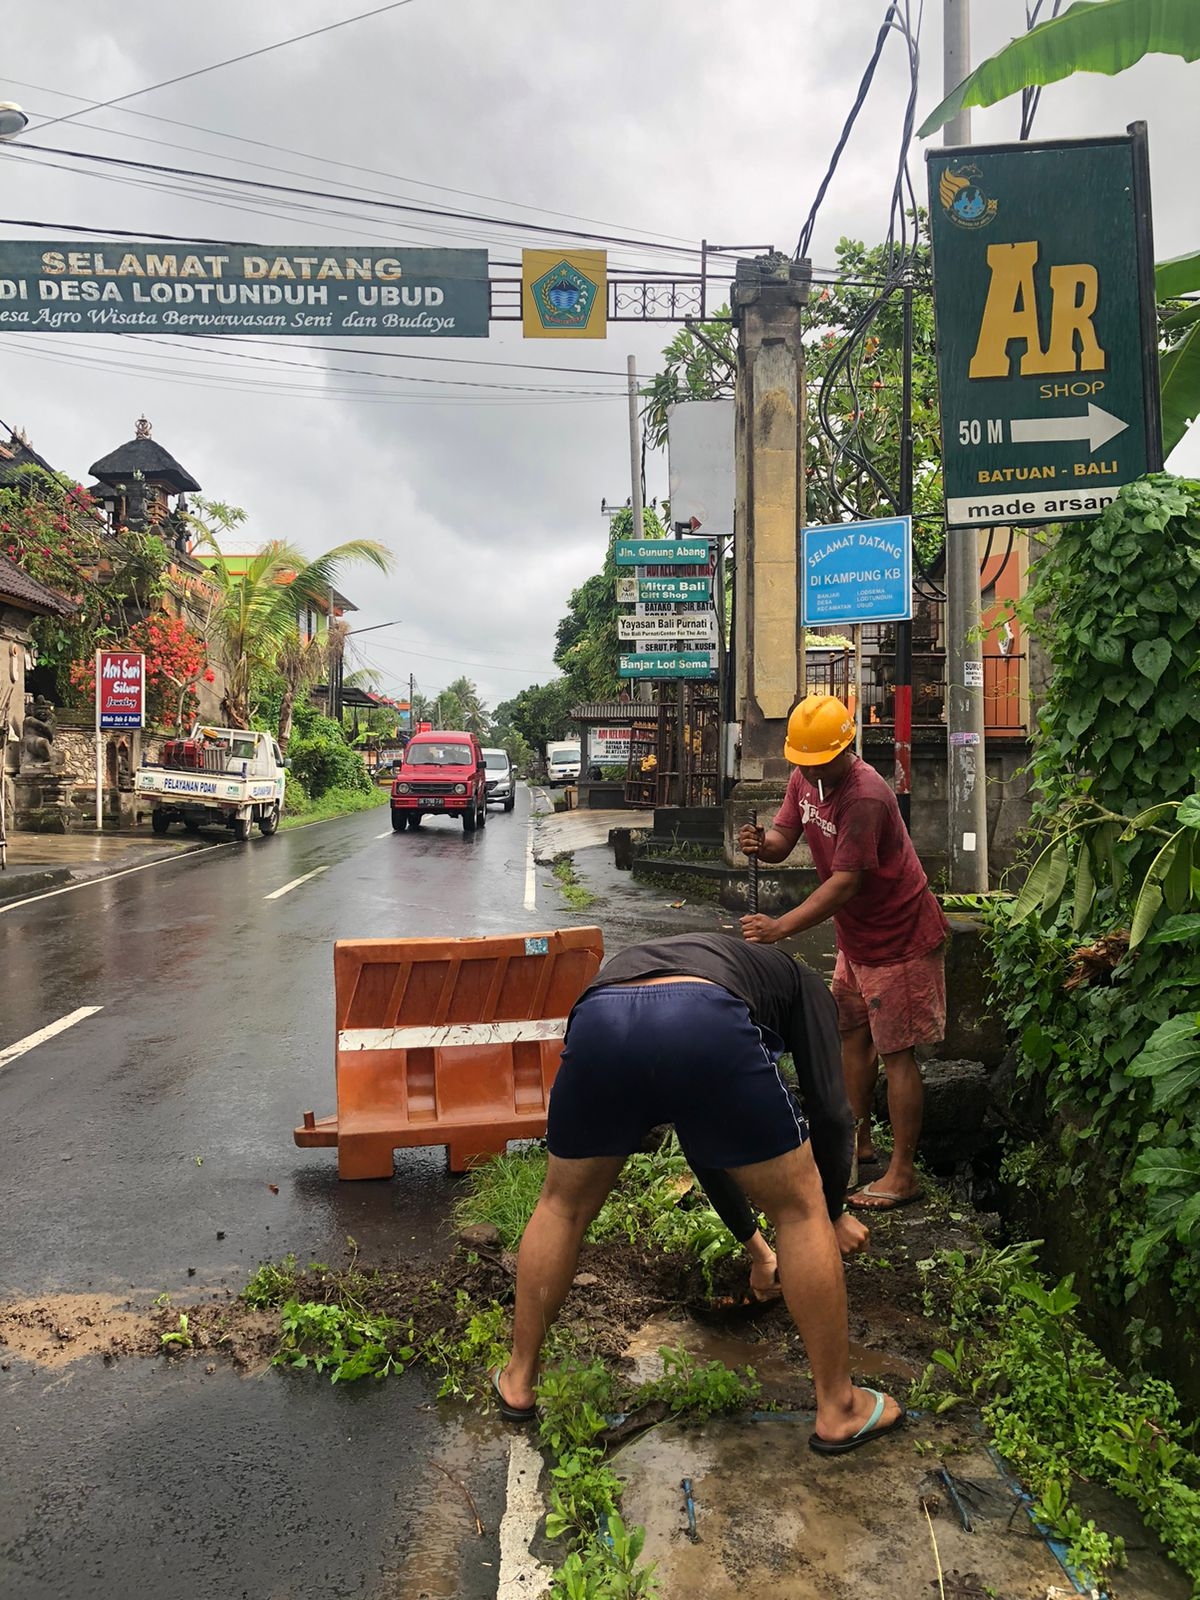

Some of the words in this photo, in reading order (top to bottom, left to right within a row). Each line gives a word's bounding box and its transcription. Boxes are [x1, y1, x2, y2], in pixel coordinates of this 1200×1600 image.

[42, 251, 229, 278] SELAMAT
[243, 256, 402, 280] DATANG
[0, 279, 27, 300] DI
[39, 280, 124, 301] DESA
[133, 282, 328, 305] LODTUNDUH
[357, 286, 445, 306] UBUD
[968, 241, 1105, 378] AR
[0, 310, 30, 323] esa
[32, 308, 82, 328] Agro
[87, 308, 158, 325] Wisata
[162, 311, 287, 327] Berwawasan
[290, 312, 333, 327] Seni
[342, 311, 378, 328] dan
[382, 312, 456, 333] Budaya
[1039, 381, 1106, 399] SHOP
[959, 419, 982, 446] 50
[987, 419, 1003, 444] M
[978, 466, 1056, 484] BATUAN
[1073, 460, 1118, 476] BALI
[968, 499, 1036, 518] made
[1044, 495, 1122, 512] arsan
[618, 548, 636, 557] Jln.
[638, 547, 674, 559] Gunung
[676, 547, 706, 559] Abang
[808, 534, 856, 568] SELAMAT
[859, 534, 902, 560] DATANG
[640, 582, 676, 591] Mitra
[679, 581, 705, 591] Bali
[810, 575, 821, 587] DI
[824, 569, 881, 585] KAMPUNG
[884, 567, 901, 579] KB
[640, 591, 660, 599] Gift
[662, 591, 688, 599] Shop
[620, 619, 656, 631] Yayasan
[658, 619, 674, 629] Bali
[676, 618, 707, 629] Purnati
[620, 660, 655, 670] Banjar
[657, 660, 676, 669] Lod
[113, 681, 140, 693] Silver
[164, 778, 199, 792] PELAYANAN
